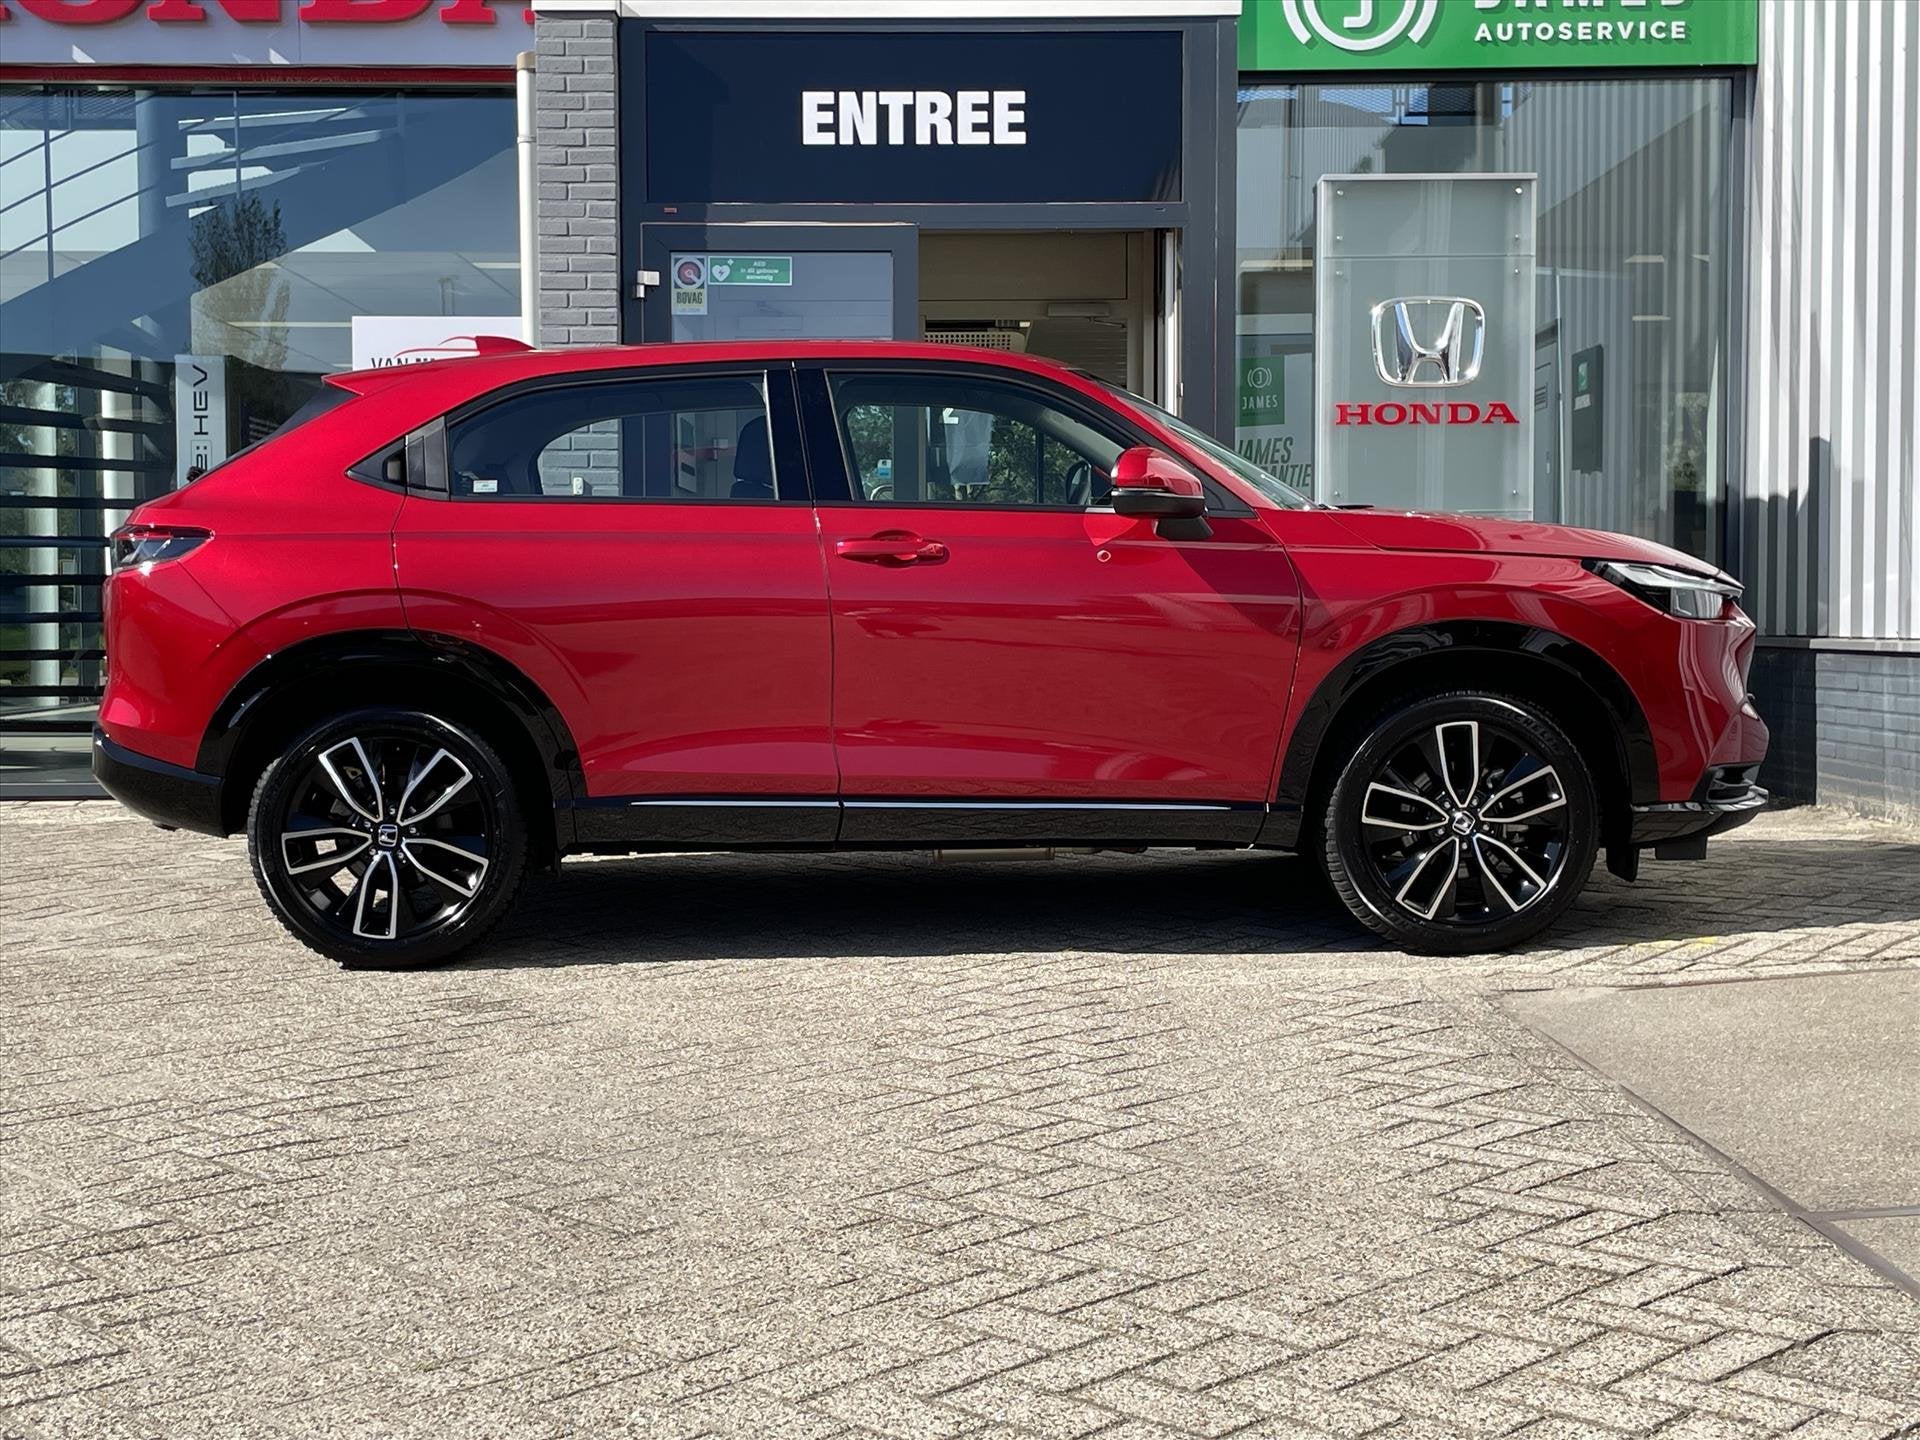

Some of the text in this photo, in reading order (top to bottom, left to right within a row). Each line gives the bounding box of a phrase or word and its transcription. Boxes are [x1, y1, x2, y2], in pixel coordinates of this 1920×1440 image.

[1474, 20, 1687, 42] AUTOSERVICE
[801, 90, 1027, 146] ENTREE
[1241, 394, 1279, 410] JAMES
[1335, 401, 1520, 426] HONDA
